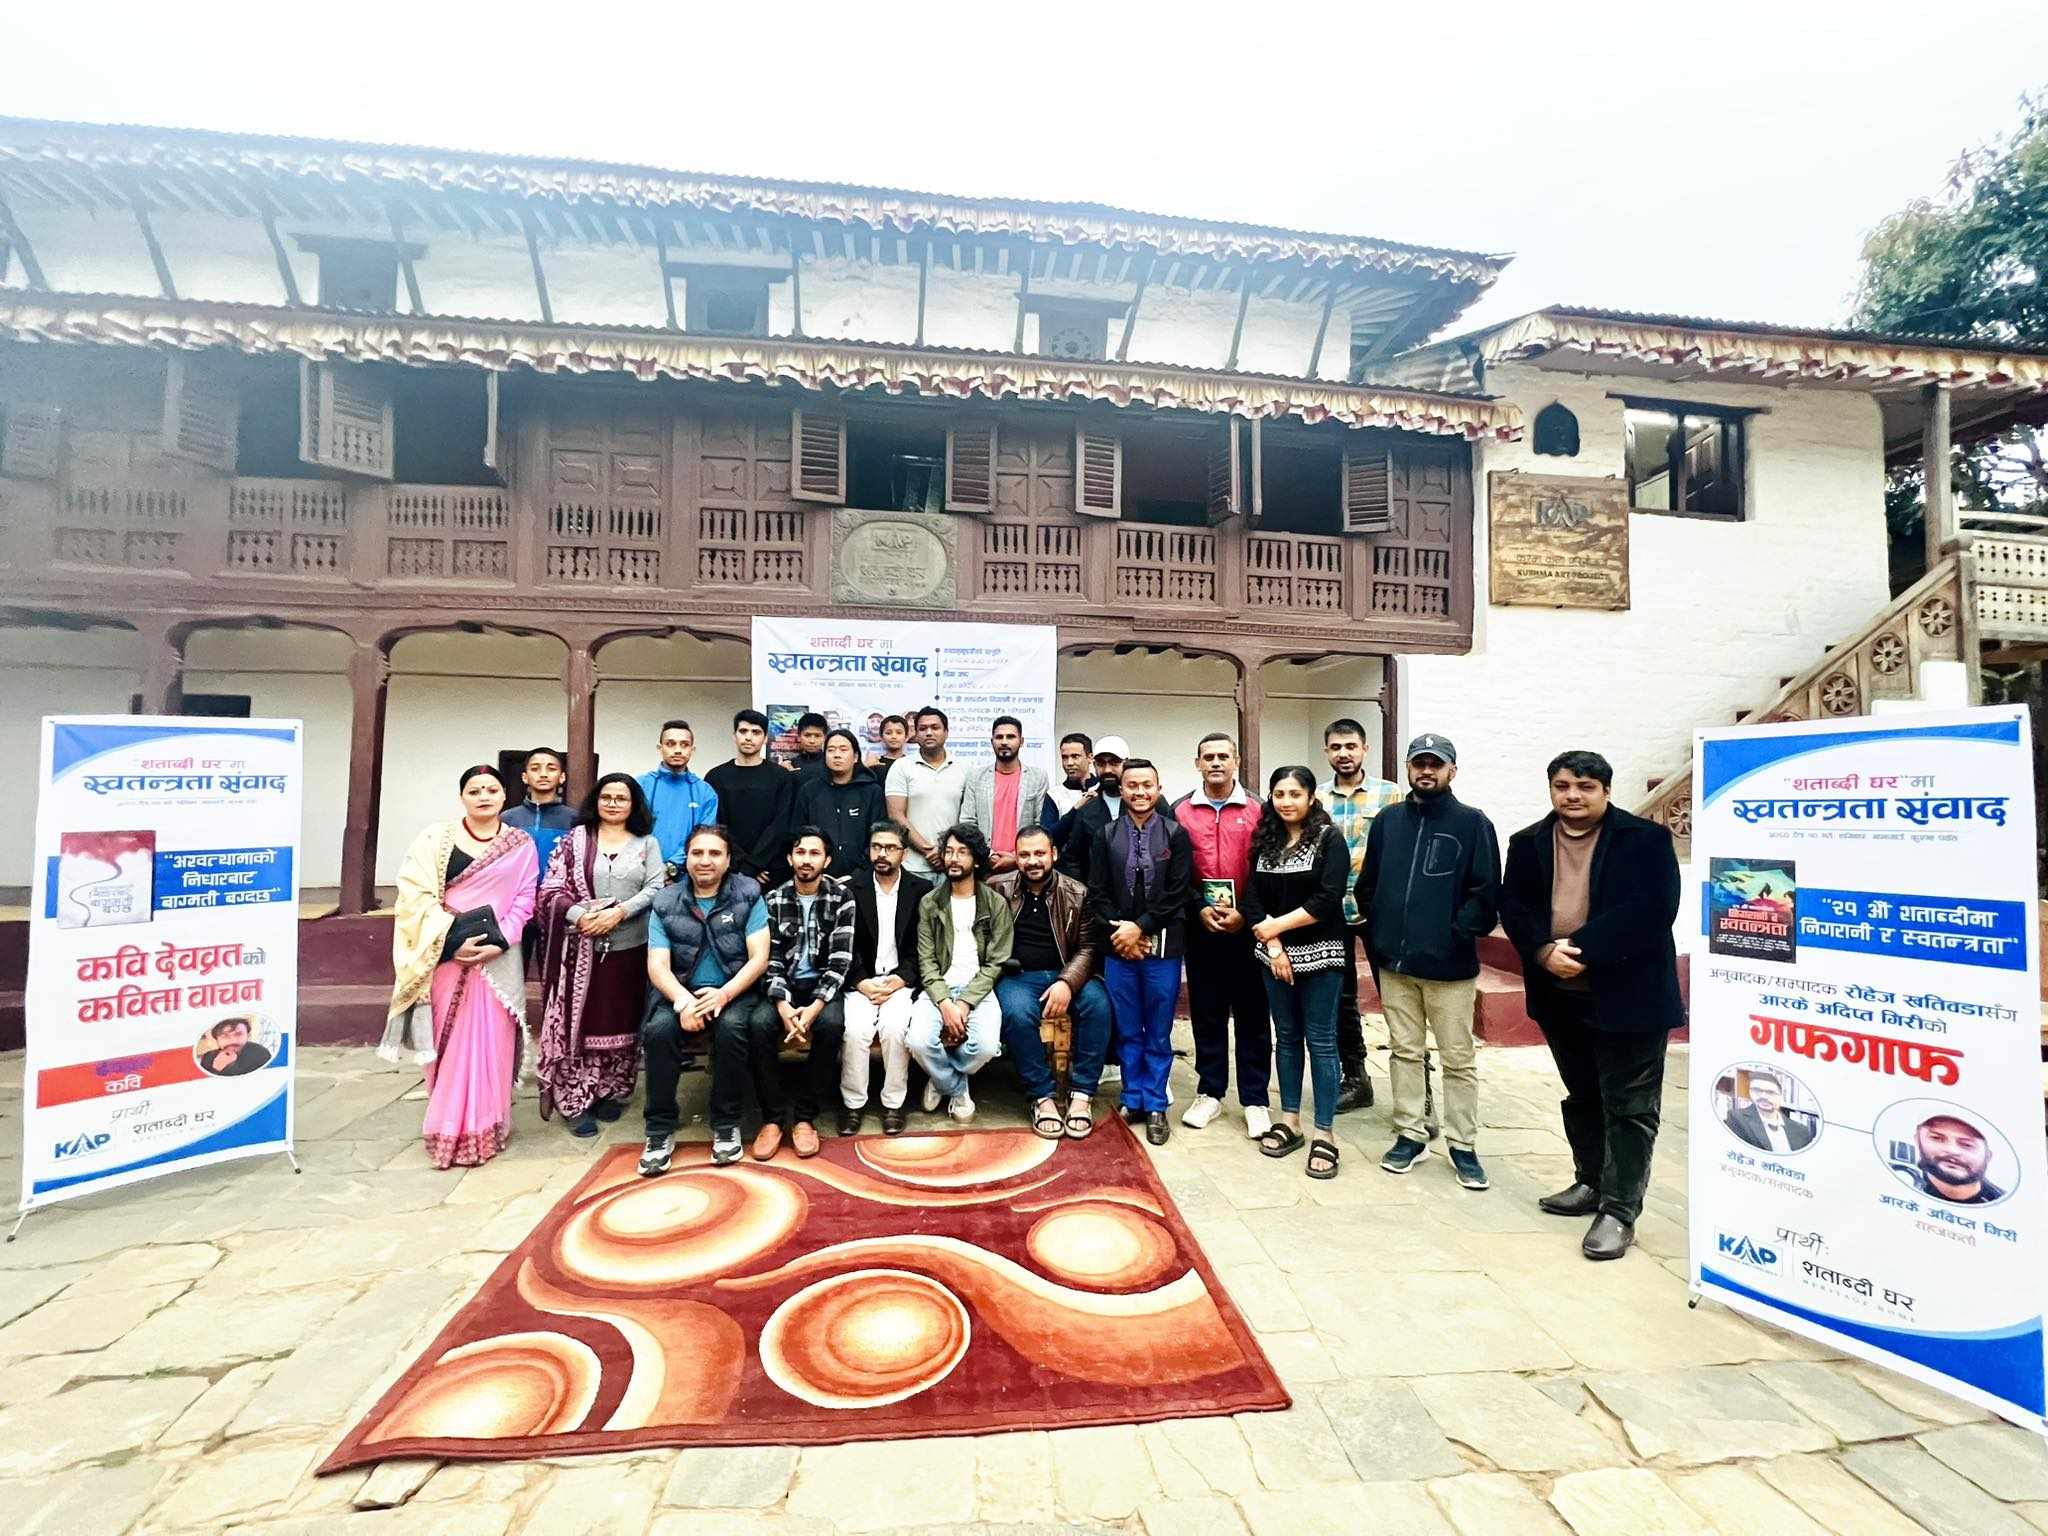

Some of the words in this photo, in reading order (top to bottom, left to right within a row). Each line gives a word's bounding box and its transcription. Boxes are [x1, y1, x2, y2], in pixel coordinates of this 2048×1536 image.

[857, 638, 875, 648] घर
[768, 652, 867, 674] स्वतन्त्रता
[871, 651, 929, 677] संवाद
[82, 775, 214, 794] स्वतन्त्रता
[219, 771, 288, 793] संवाद
[1732, 798, 1888, 824] स्वतन्त्रता
[1895, 791, 2010, 826] संवाद
[182, 870, 258, 888] निधारबाट
[1800, 916, 1875, 942] निगरानी
[1878, 927, 1896, 944] र
[1899, 905, 1999, 928] शताब्दीमा
[77, 945, 150, 982] कवि
[77, 984, 184, 1024] कविता
[188, 978, 264, 1009] वाचन
[1758, 993, 1809, 1011] आरके
[1816, 1001, 1874, 1022] अदिप्त
[1845, 984, 1896, 1005] रोहेज
[1749, 1014, 1965, 1087] गफगाफ
[104, 1074, 144, 1093] कवि
[55, 1132, 112, 1159] KAP
[1718, 1233, 1778, 1266] KAP
[1802, 1260, 1874, 1297] शताब्दी
[1882, 1287, 1917, 1312] घर
